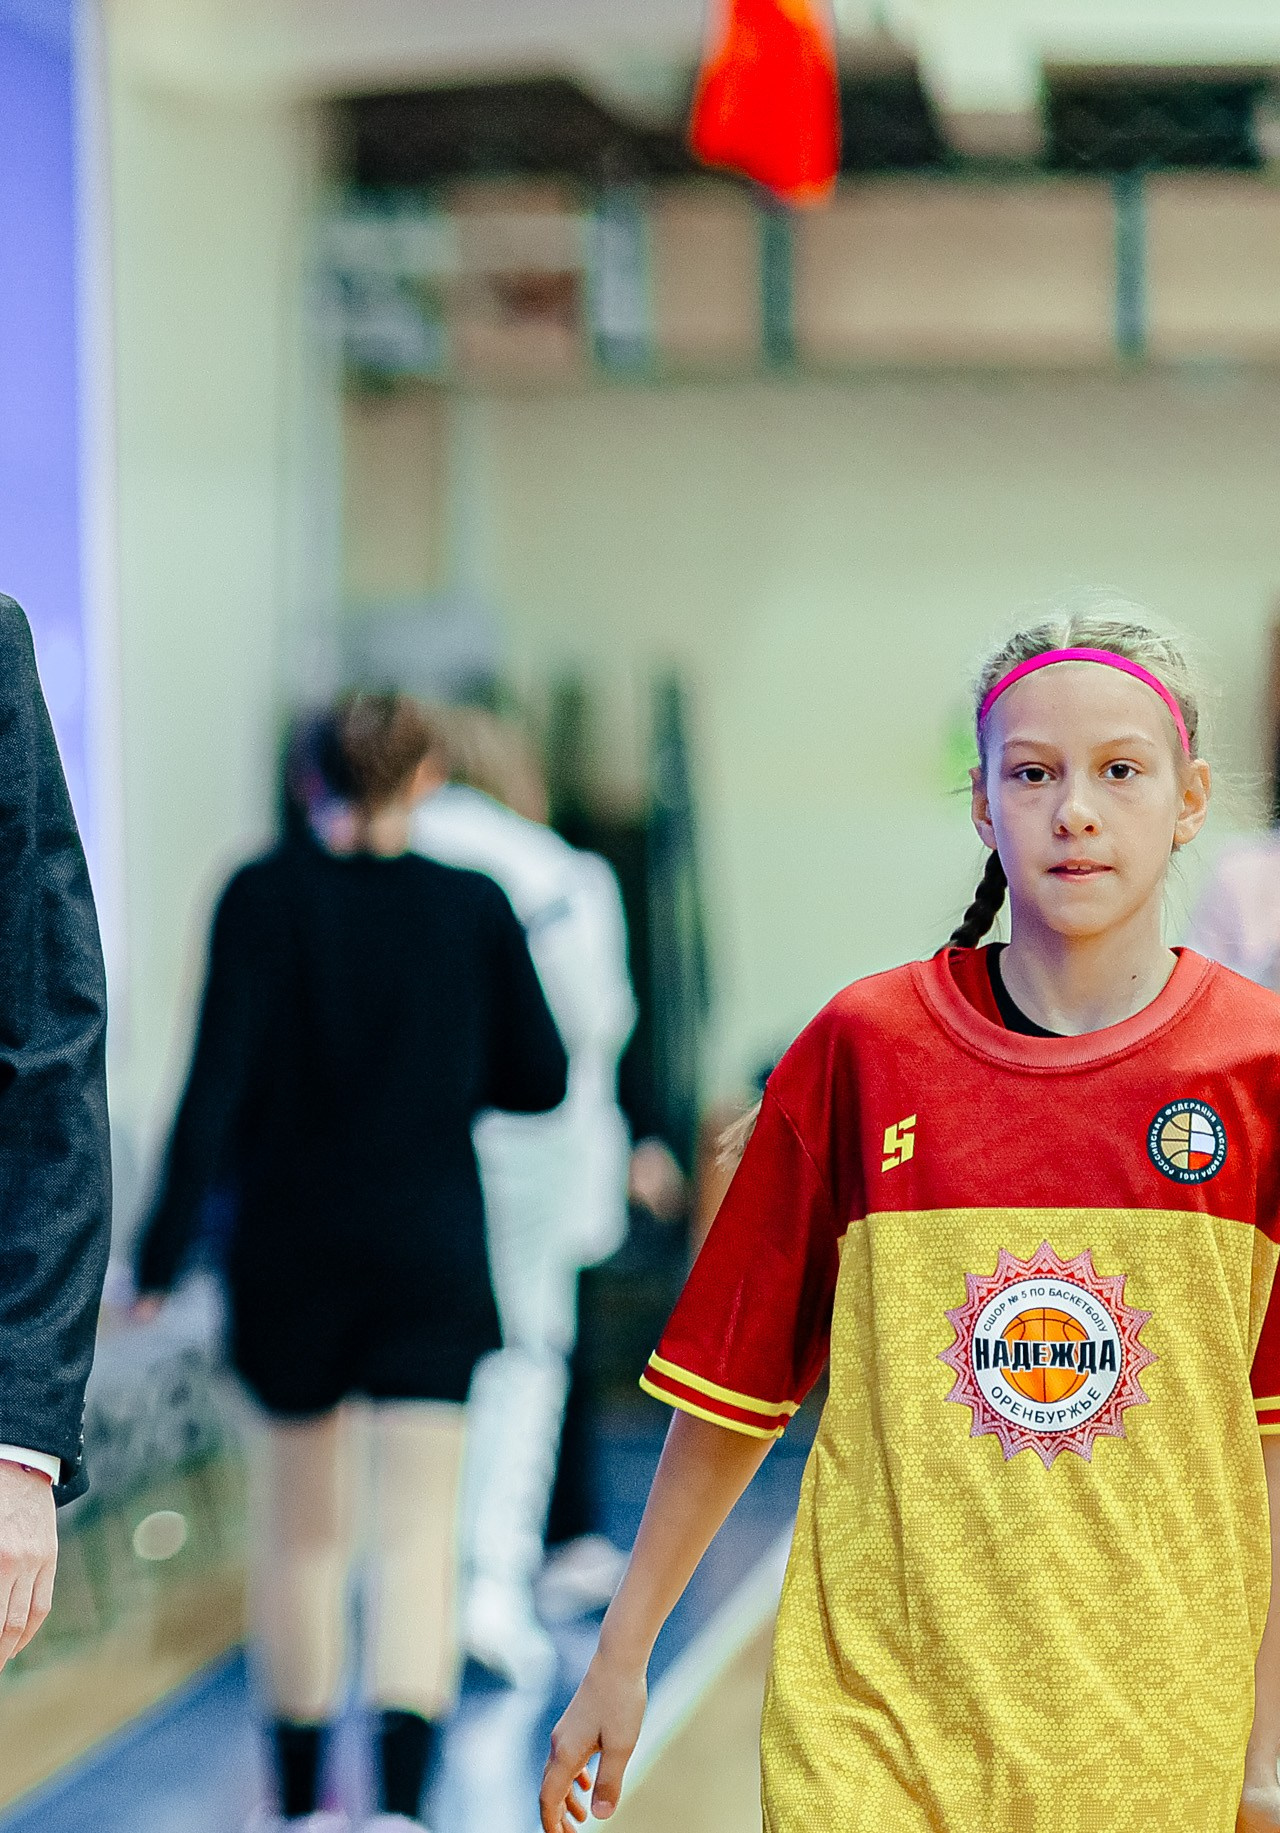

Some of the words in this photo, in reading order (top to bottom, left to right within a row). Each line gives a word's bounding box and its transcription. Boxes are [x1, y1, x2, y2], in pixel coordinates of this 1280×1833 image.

[1150, 1116, 1175, 1175] РОССИЙСКАЯ
[1165, 1102, 1217, 1123] ФЕДЕРАЦИЯ
[1201, 1125, 1225, 1178] БАСКЕТБОЛА
[983, 1302, 1008, 1332] СШОР
[1008, 1294, 1019, 1306] №
[1021, 1290, 1028, 1299] 5
[1029, 1287, 1045, 1298] ПО
[1049, 1287, 1108, 1333] БАСКЕТБОЛУ
[974, 1337, 1117, 1374] НАДЕЖДА
[991, 1386, 1102, 1424] ОРЕНБУРЖЬЕ
